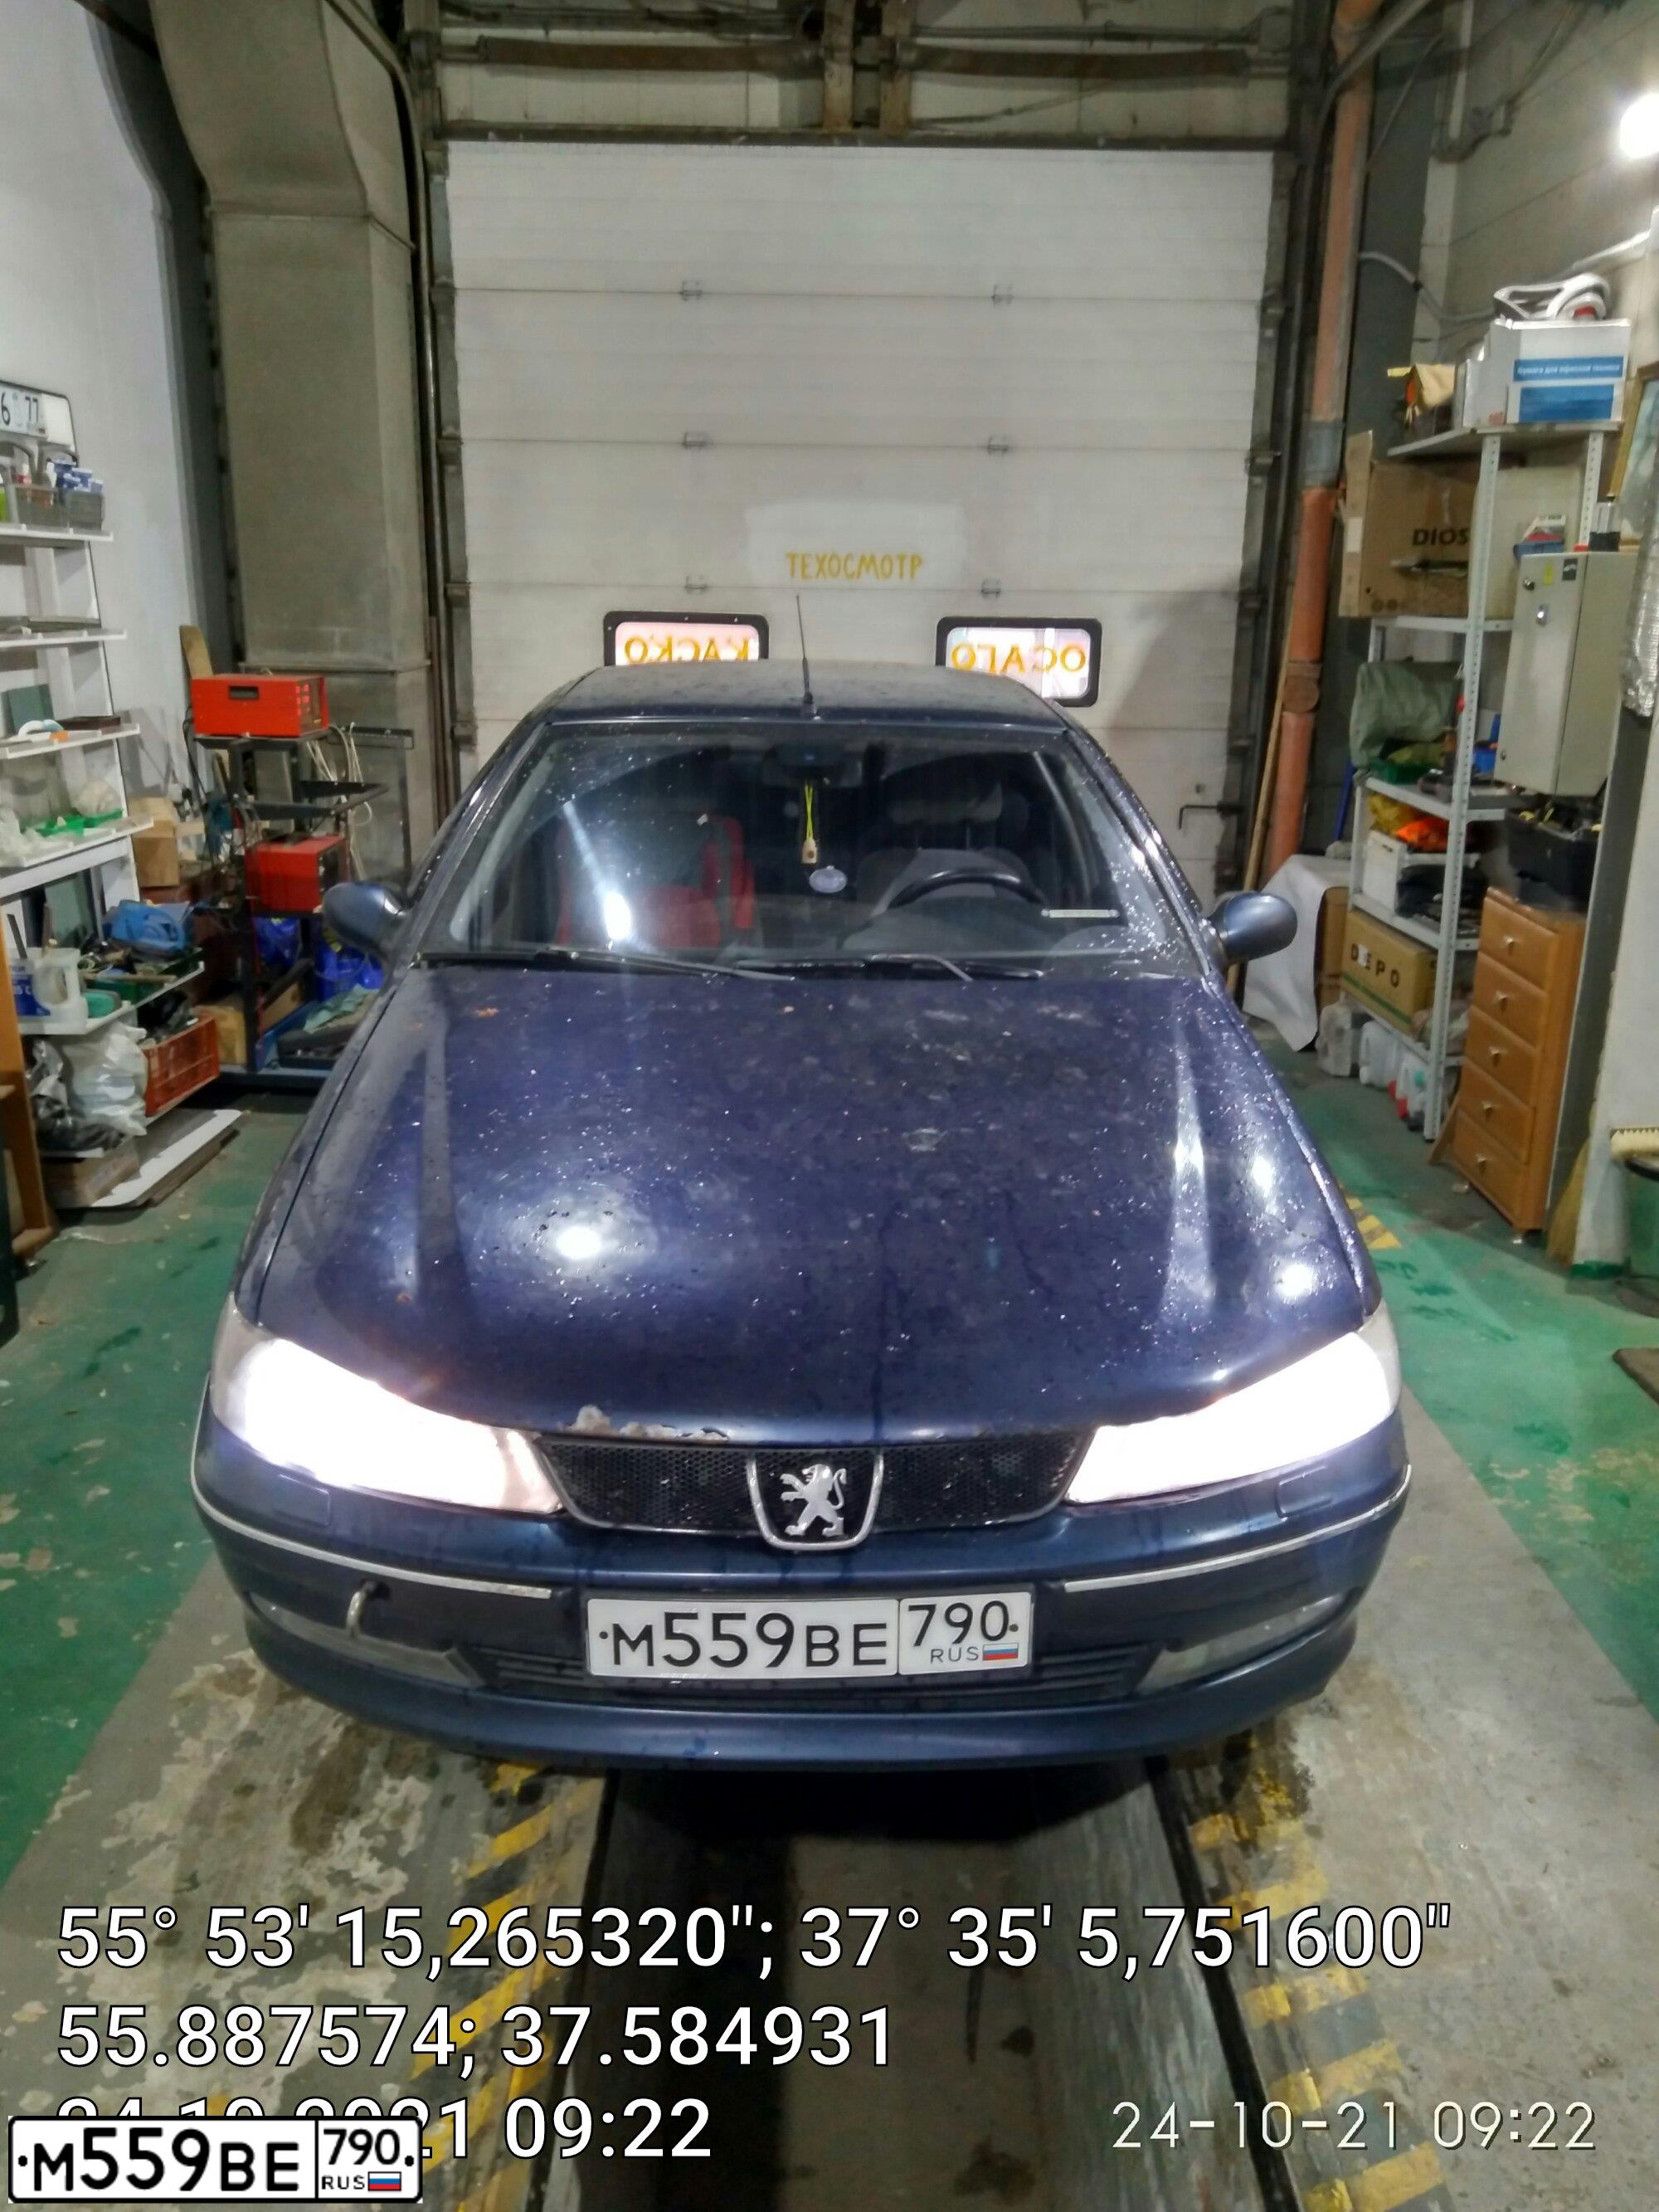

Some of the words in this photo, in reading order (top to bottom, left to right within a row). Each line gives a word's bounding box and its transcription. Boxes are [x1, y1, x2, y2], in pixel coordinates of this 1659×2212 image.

[786, 552, 923, 580] ТЕХОСМОТР
[907, 1600, 1010, 1647] 790
[931, 1646, 980, 1664] RUS
